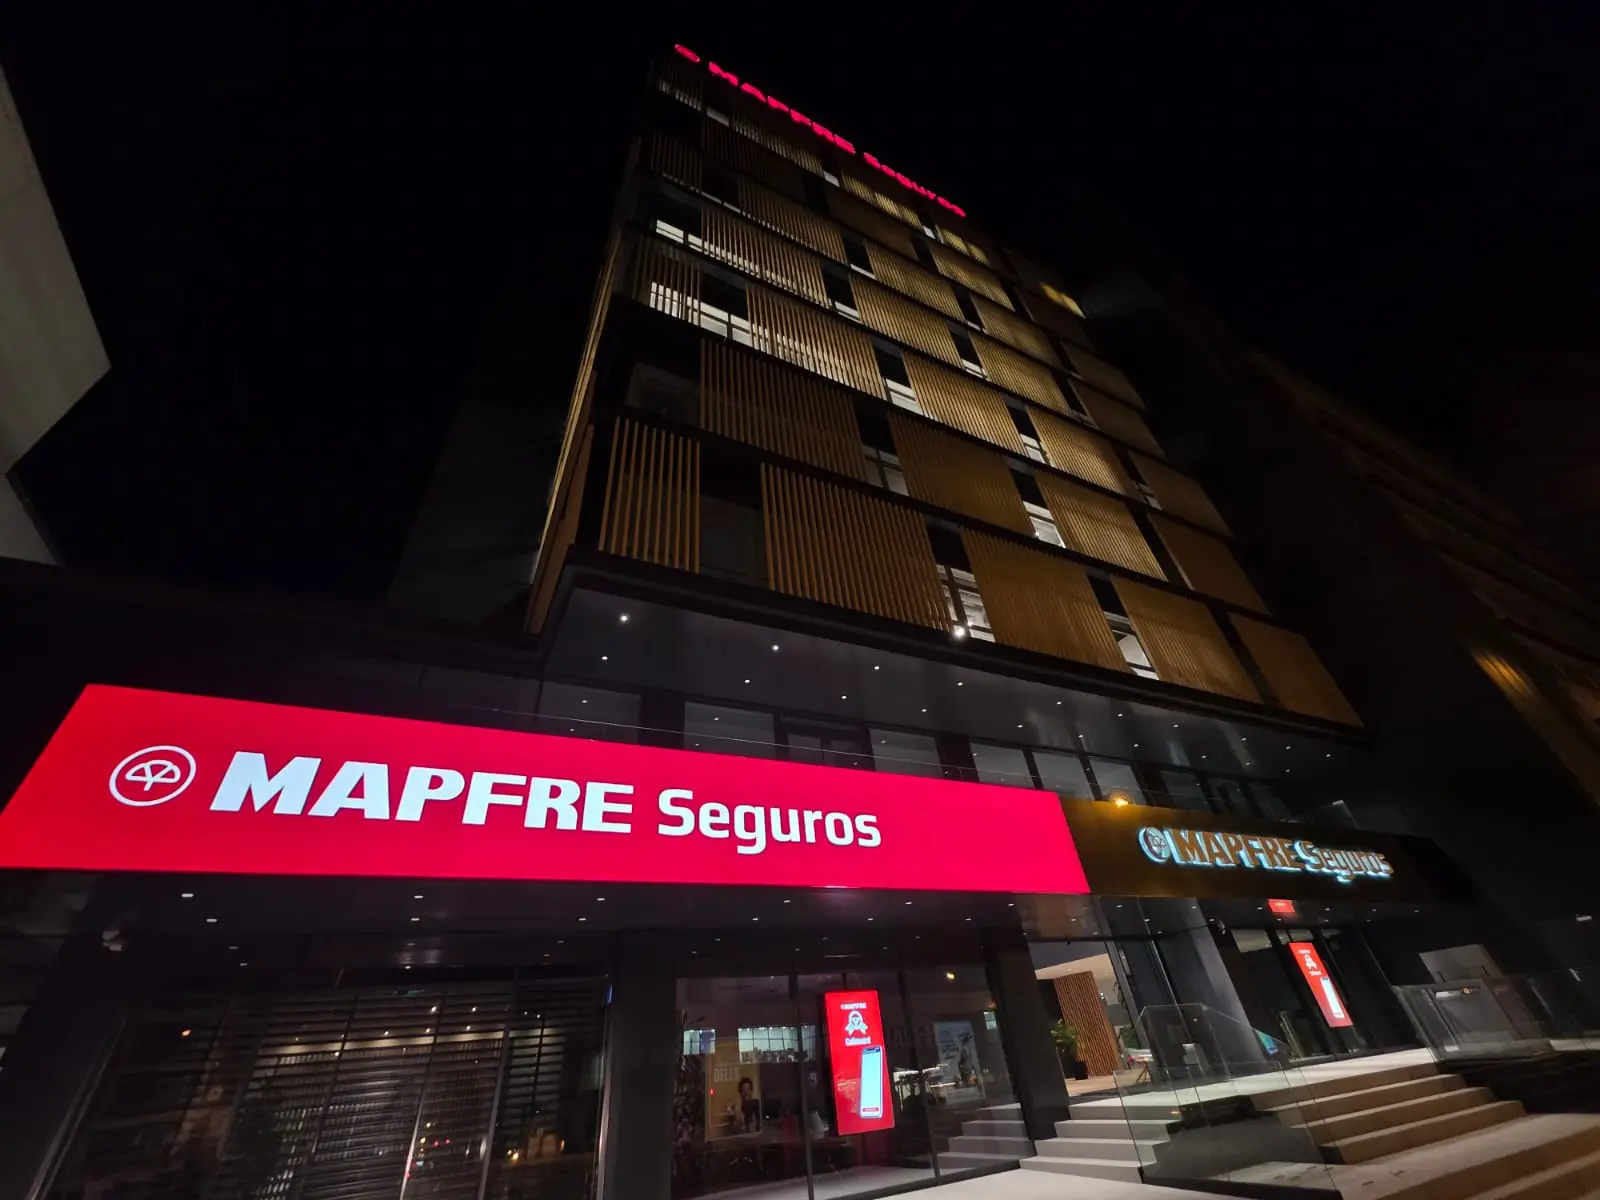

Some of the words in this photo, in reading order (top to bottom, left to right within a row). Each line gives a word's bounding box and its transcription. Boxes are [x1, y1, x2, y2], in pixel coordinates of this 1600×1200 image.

[209, 751, 634, 834] MAPFRE
[658, 788, 882, 855] Seguros
[1164, 827, 1304, 872] MAPFRE
[1294, 839, 1395, 882] Seguros
